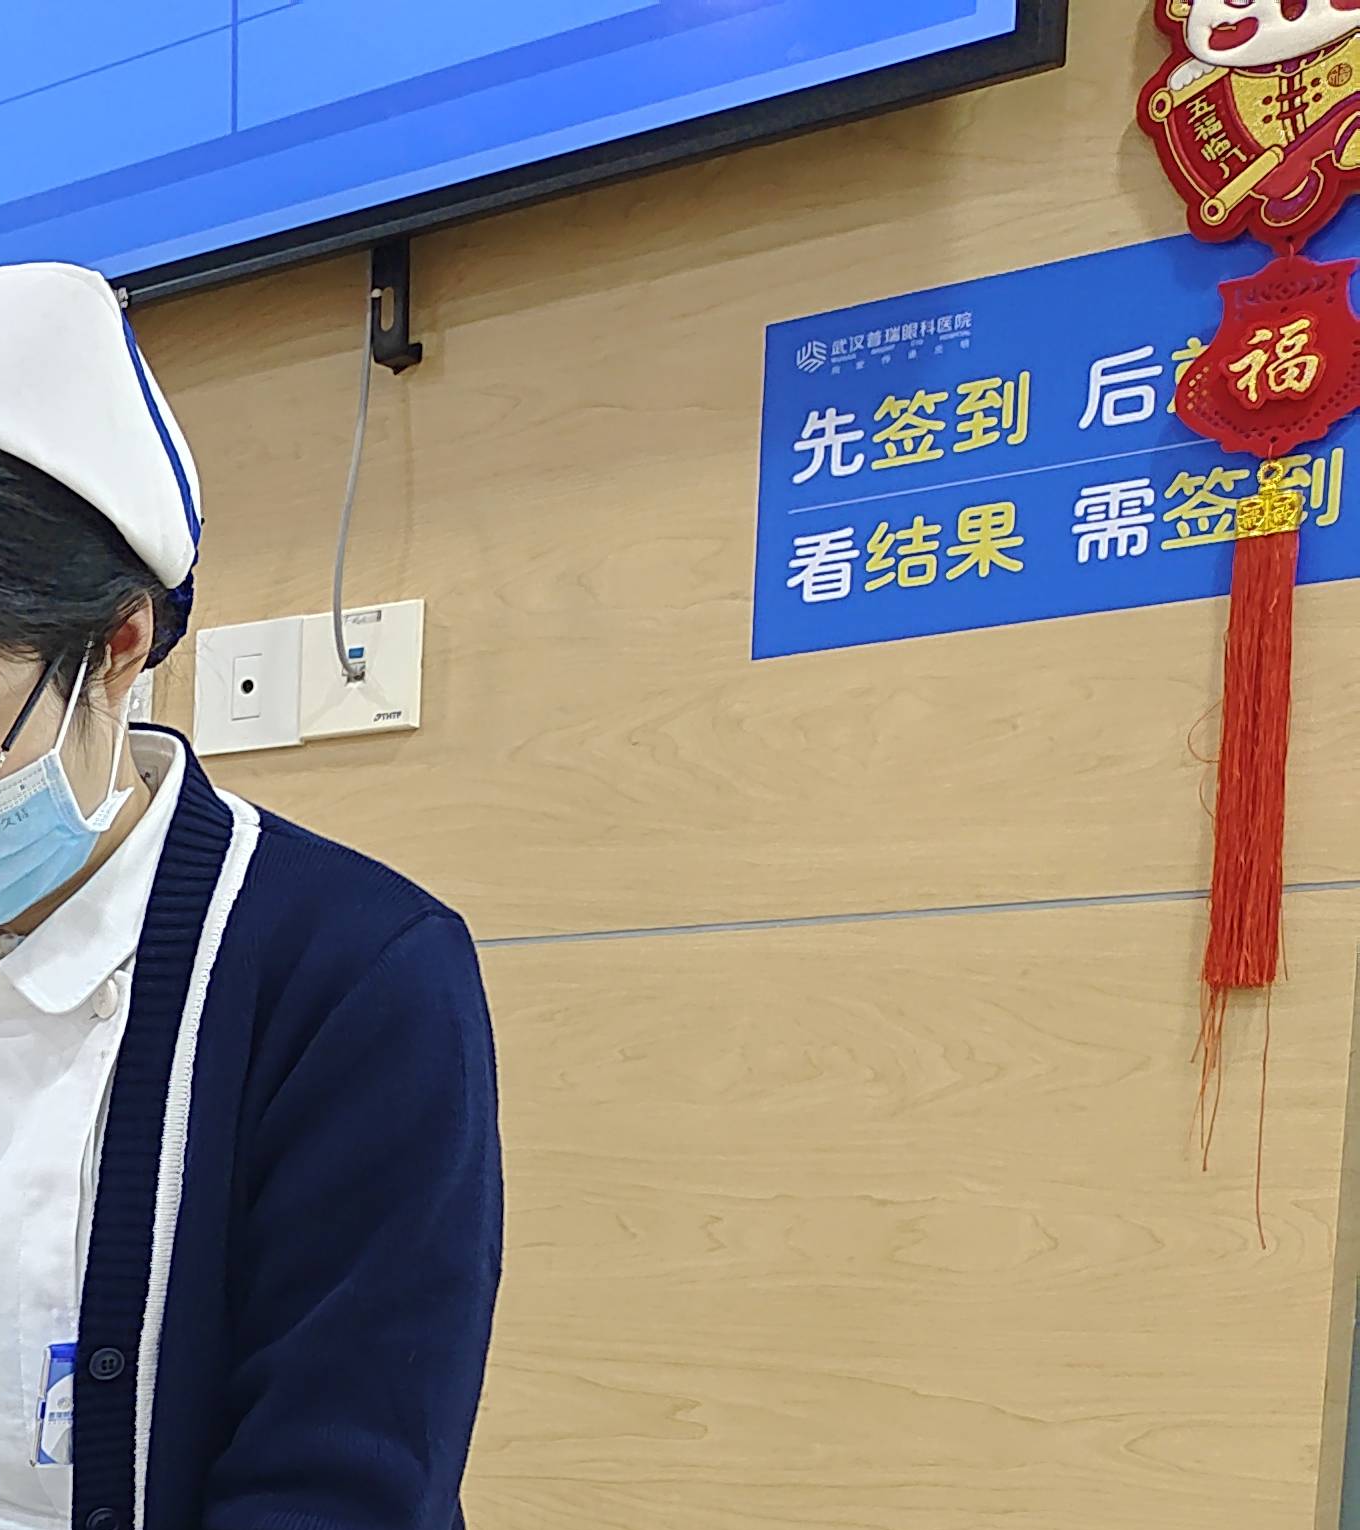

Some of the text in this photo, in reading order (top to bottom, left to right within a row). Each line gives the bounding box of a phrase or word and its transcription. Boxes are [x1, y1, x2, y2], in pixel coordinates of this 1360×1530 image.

[831, 312, 972, 355] 武汉普瑞眼科医院
[1229, 317, 1318, 404] 福
[792, 370, 1032, 486] 先签到
[786, 447, 1344, 604] 看结果 需签到
